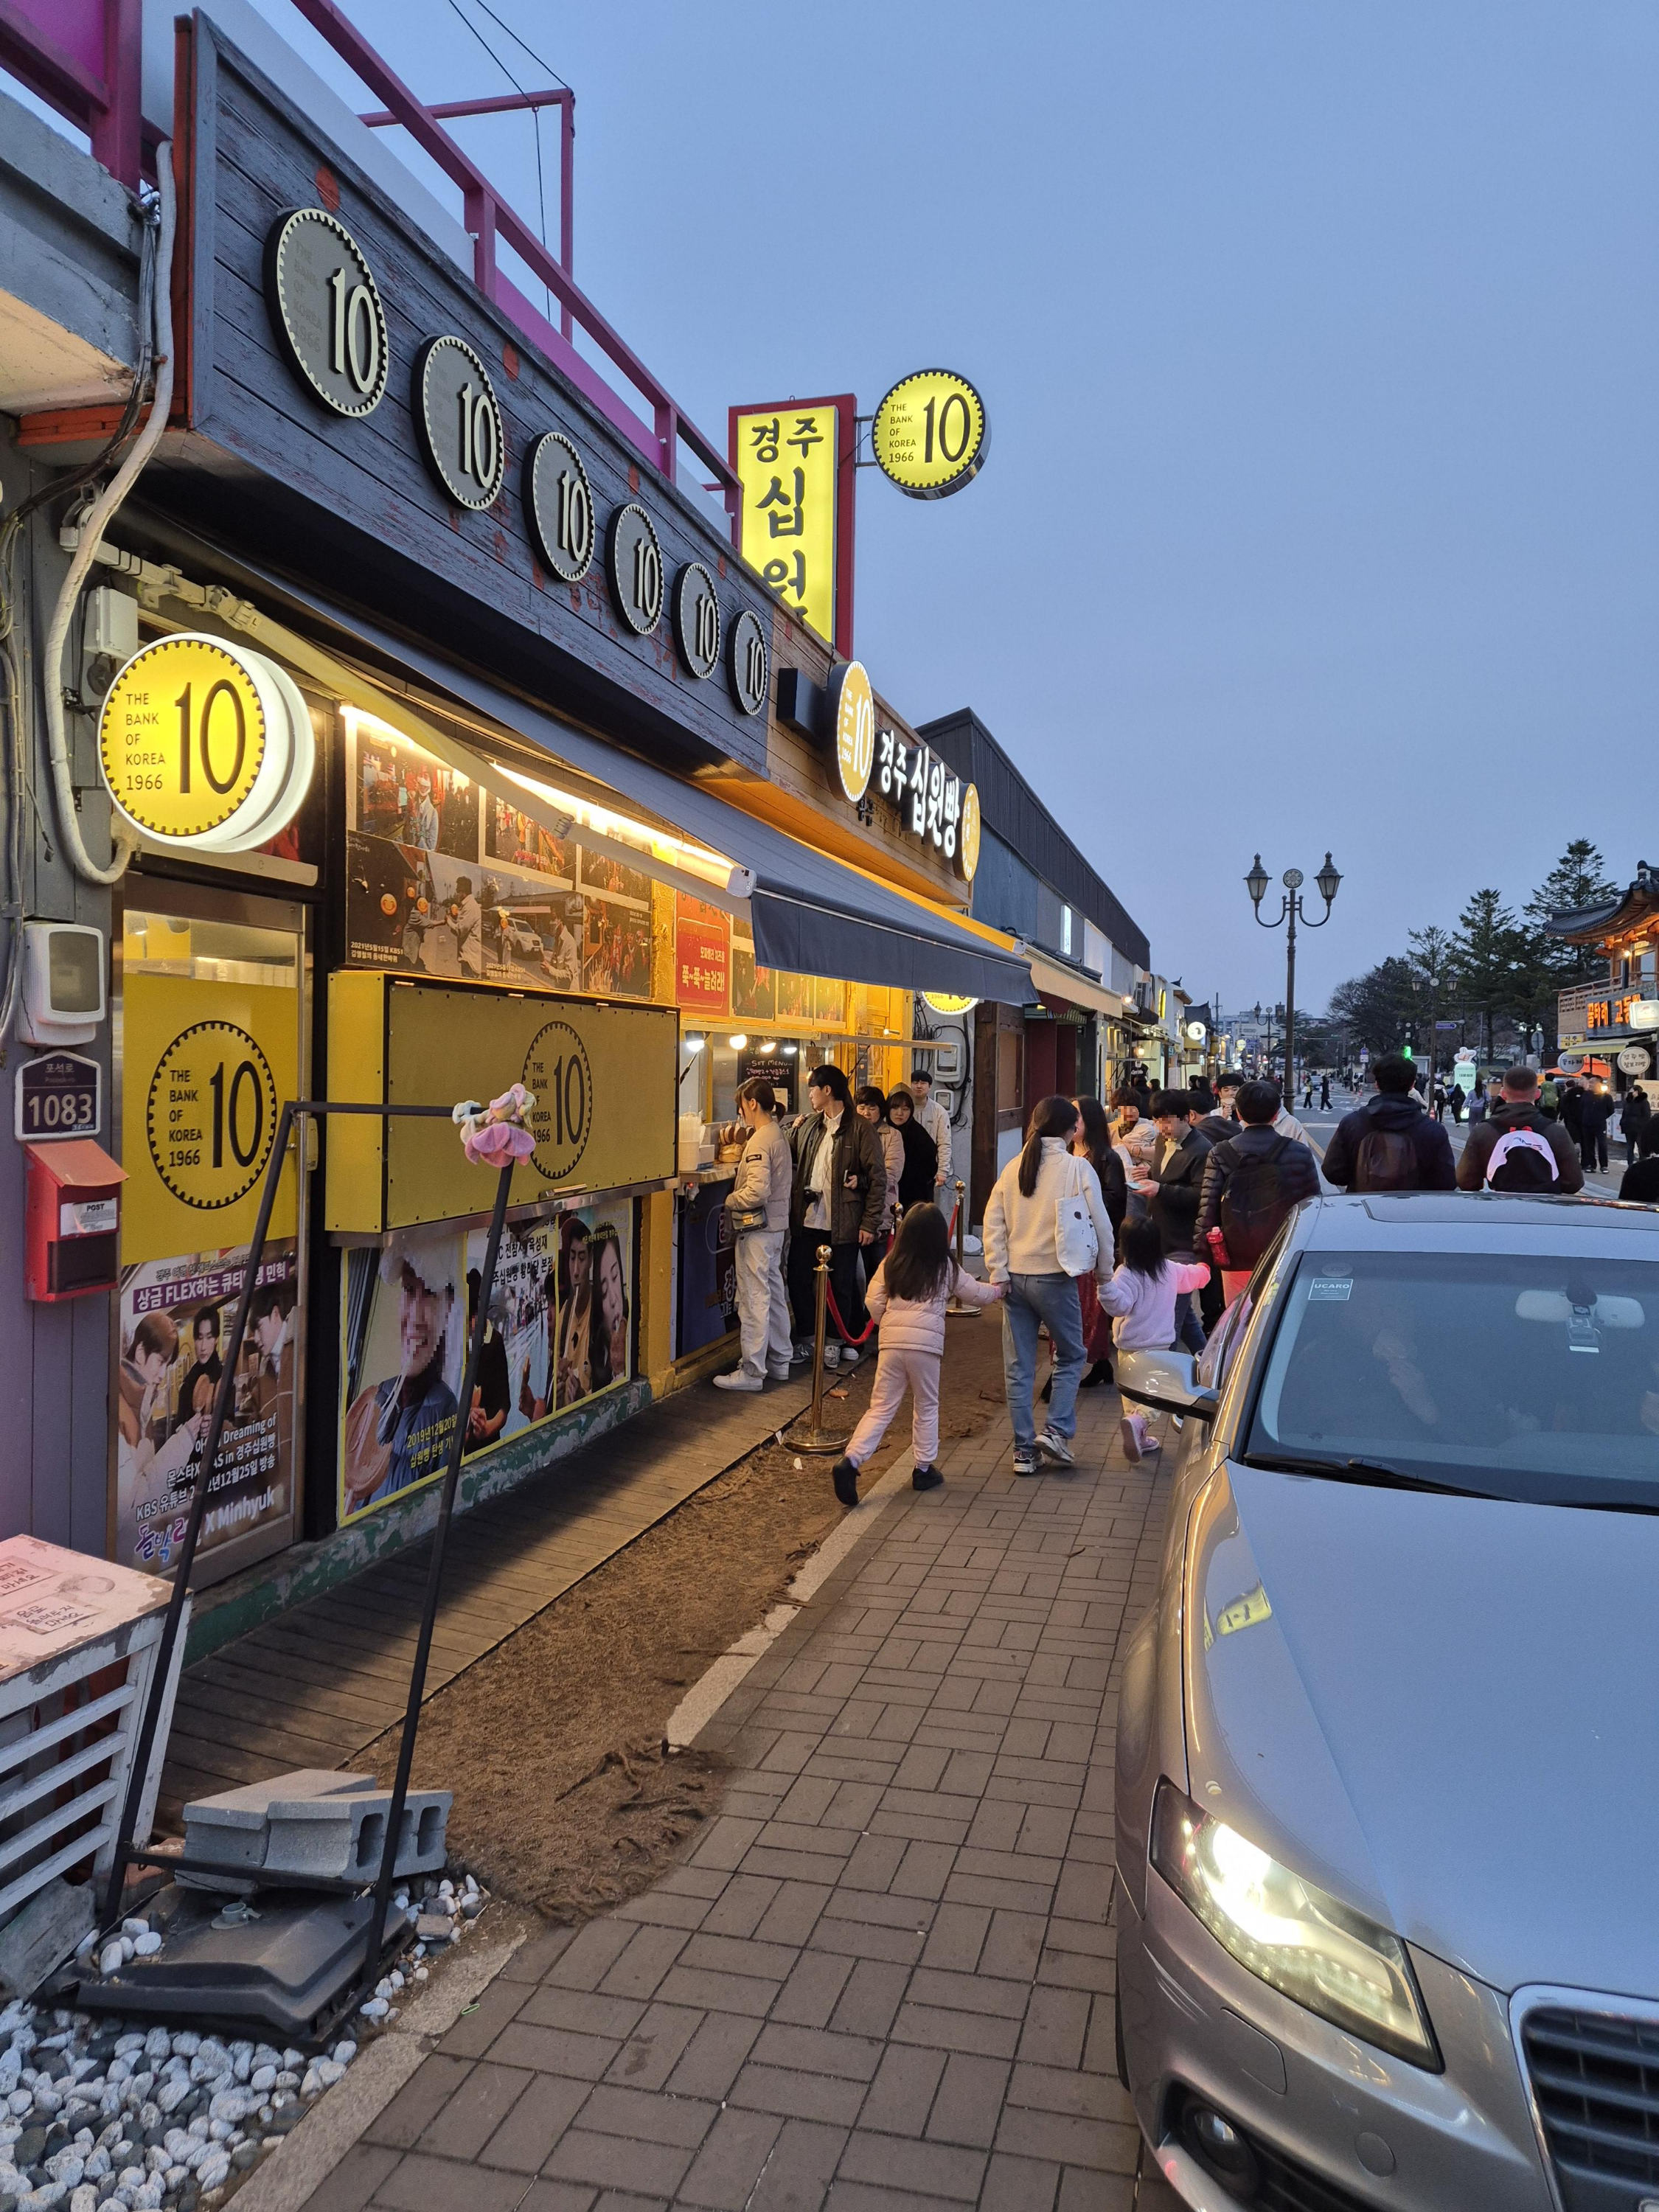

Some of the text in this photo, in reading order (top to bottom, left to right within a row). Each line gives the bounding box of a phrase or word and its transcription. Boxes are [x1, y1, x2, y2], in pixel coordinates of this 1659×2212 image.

[333, 267, 379, 393] 10
[891, 403, 907, 413] THE
[890, 415, 913, 425] BANK
[923, 392, 970, 463] 10
[461, 382, 497, 488] 10
[748, 417, 824, 463] 경주
[889, 428, 900, 437] OF
[888, 438, 917, 448] KOREA
[888, 451, 914, 463] 1966
[562, 470, 589, 562] 10
[638, 538, 658, 617] 10
[700, 593, 717, 663] 10
[751, 637, 765, 700] 10
[126, 692, 149, 706] THE
[126, 712, 159, 726] BANK
[125, 733, 141, 746] OF
[175, 679, 246, 795] 10
[853, 693, 872, 779] 10
[126, 752, 166, 765] KOREA
[880, 729, 908, 801] 경주
[126, 774, 163, 790] 1966
[45, 1063, 74, 1077] 포석로
[170, 1070, 190, 1082] THE
[532, 1062, 544, 1073] THE
[532, 1079, 549, 1090] BANK
[170, 1090, 198, 1102] BANK
[554, 1054, 585, 1144] 10
[28, 1093, 92, 1127] 1083
[169, 1110, 184, 1122] OF
[209, 1060, 263, 1168] 10
[532, 1112, 552, 1123] KOREA
[169, 1129, 203, 1142] KOREA
[533, 1128, 551, 1143] 1966
[169, 1149, 201, 1167] 1966
[86, 1203, 105, 1211] POST
[156, 1267, 171, 1281] 경주
[172, 1264, 187, 1279] 여행
[493, 1263, 518, 1287] 주십원빵
[541, 1255, 554, 1273] 본점
[137, 1287, 162, 1311] 상금
[165, 1277, 219, 1304] FLEX하는
[267, 1260, 287, 1284] 민혁
[224, 1420, 265, 1444] Dreaming
[268, 1412, 277, 1428] of
[226, 1450, 234, 1464] in
[236, 1433, 276, 1461] 경주십원빵
[136, 1498, 158, 1523] KBS
[160, 1484, 187, 1514] 유튜브
[260, 1453, 276, 1472] 방송
[218, 1485, 276, 1530] Minhyuk
